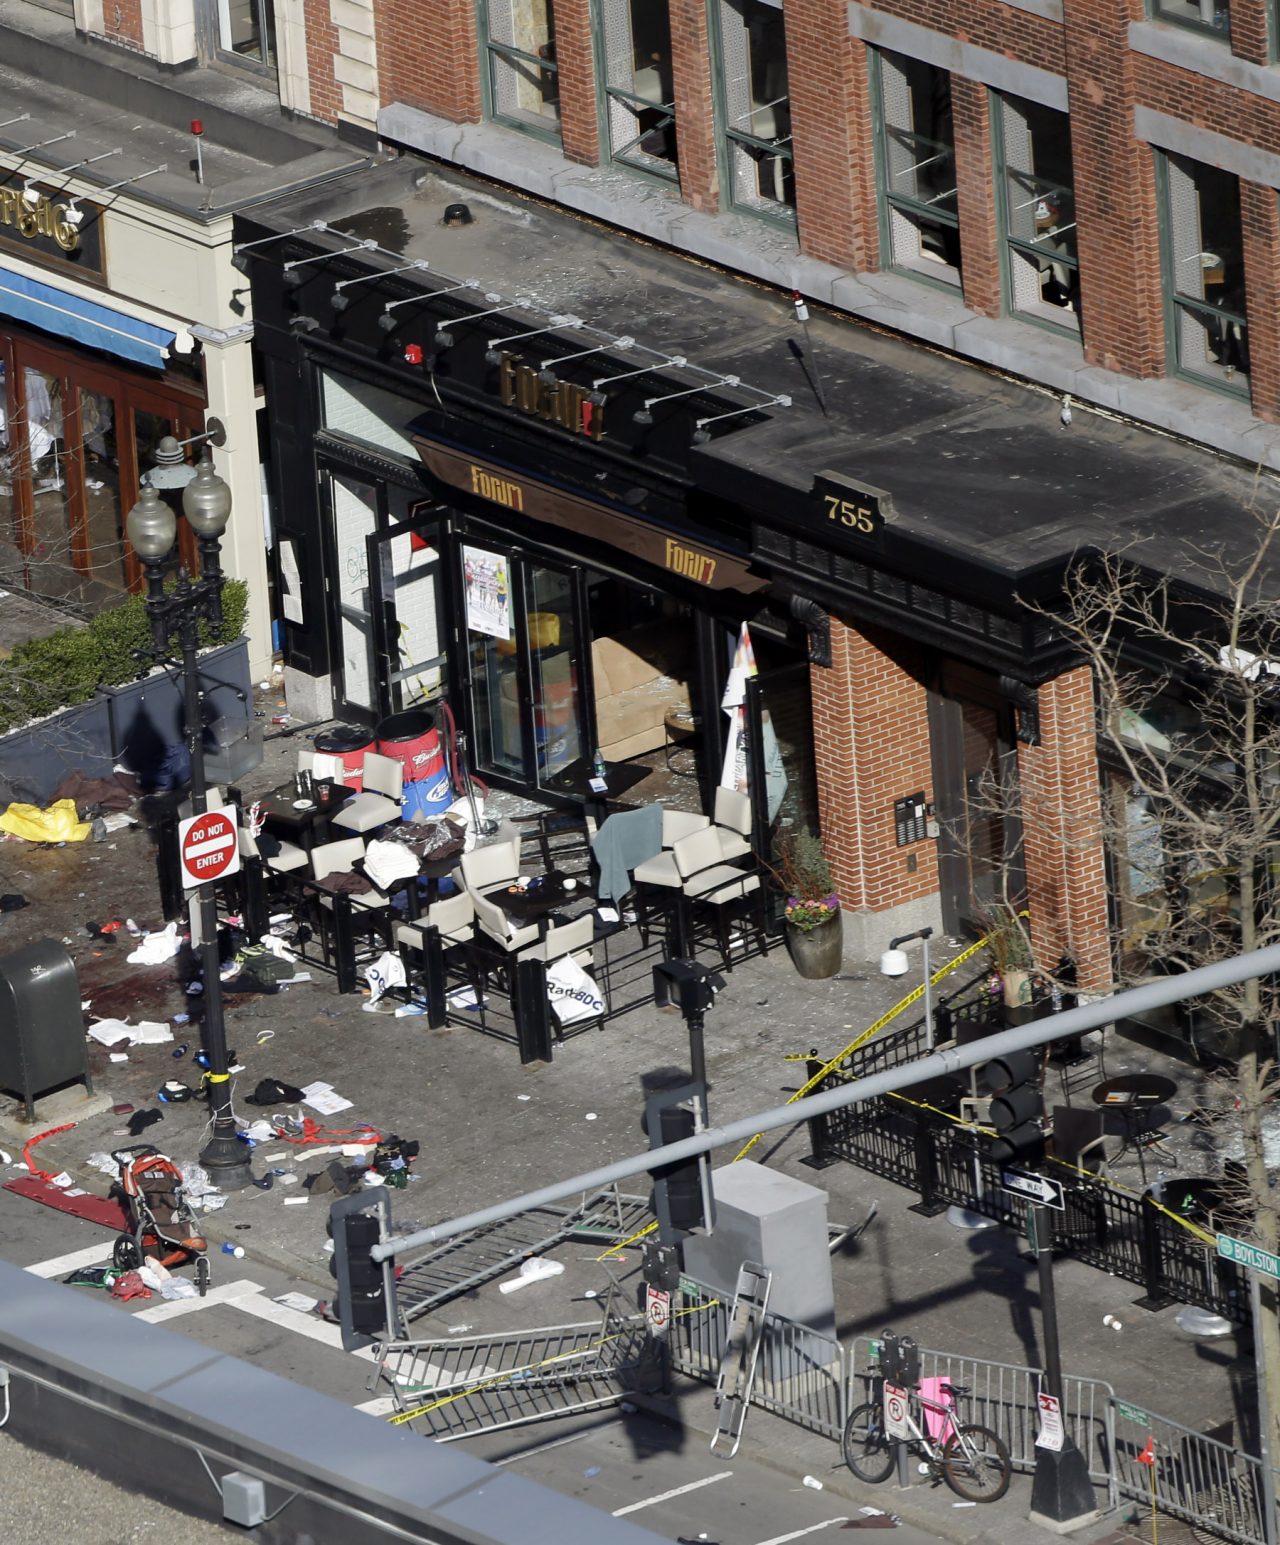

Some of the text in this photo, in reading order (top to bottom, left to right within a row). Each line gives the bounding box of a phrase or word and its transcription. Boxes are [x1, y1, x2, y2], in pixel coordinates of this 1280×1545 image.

[824, 495, 874, 533] 755
[192, 822, 224, 842] DO NOT
[197, 852, 224, 869] ENTER
[1026, 1181, 1043, 1192] WAY
[1234, 1243, 1278, 1275] BOYLSTON
